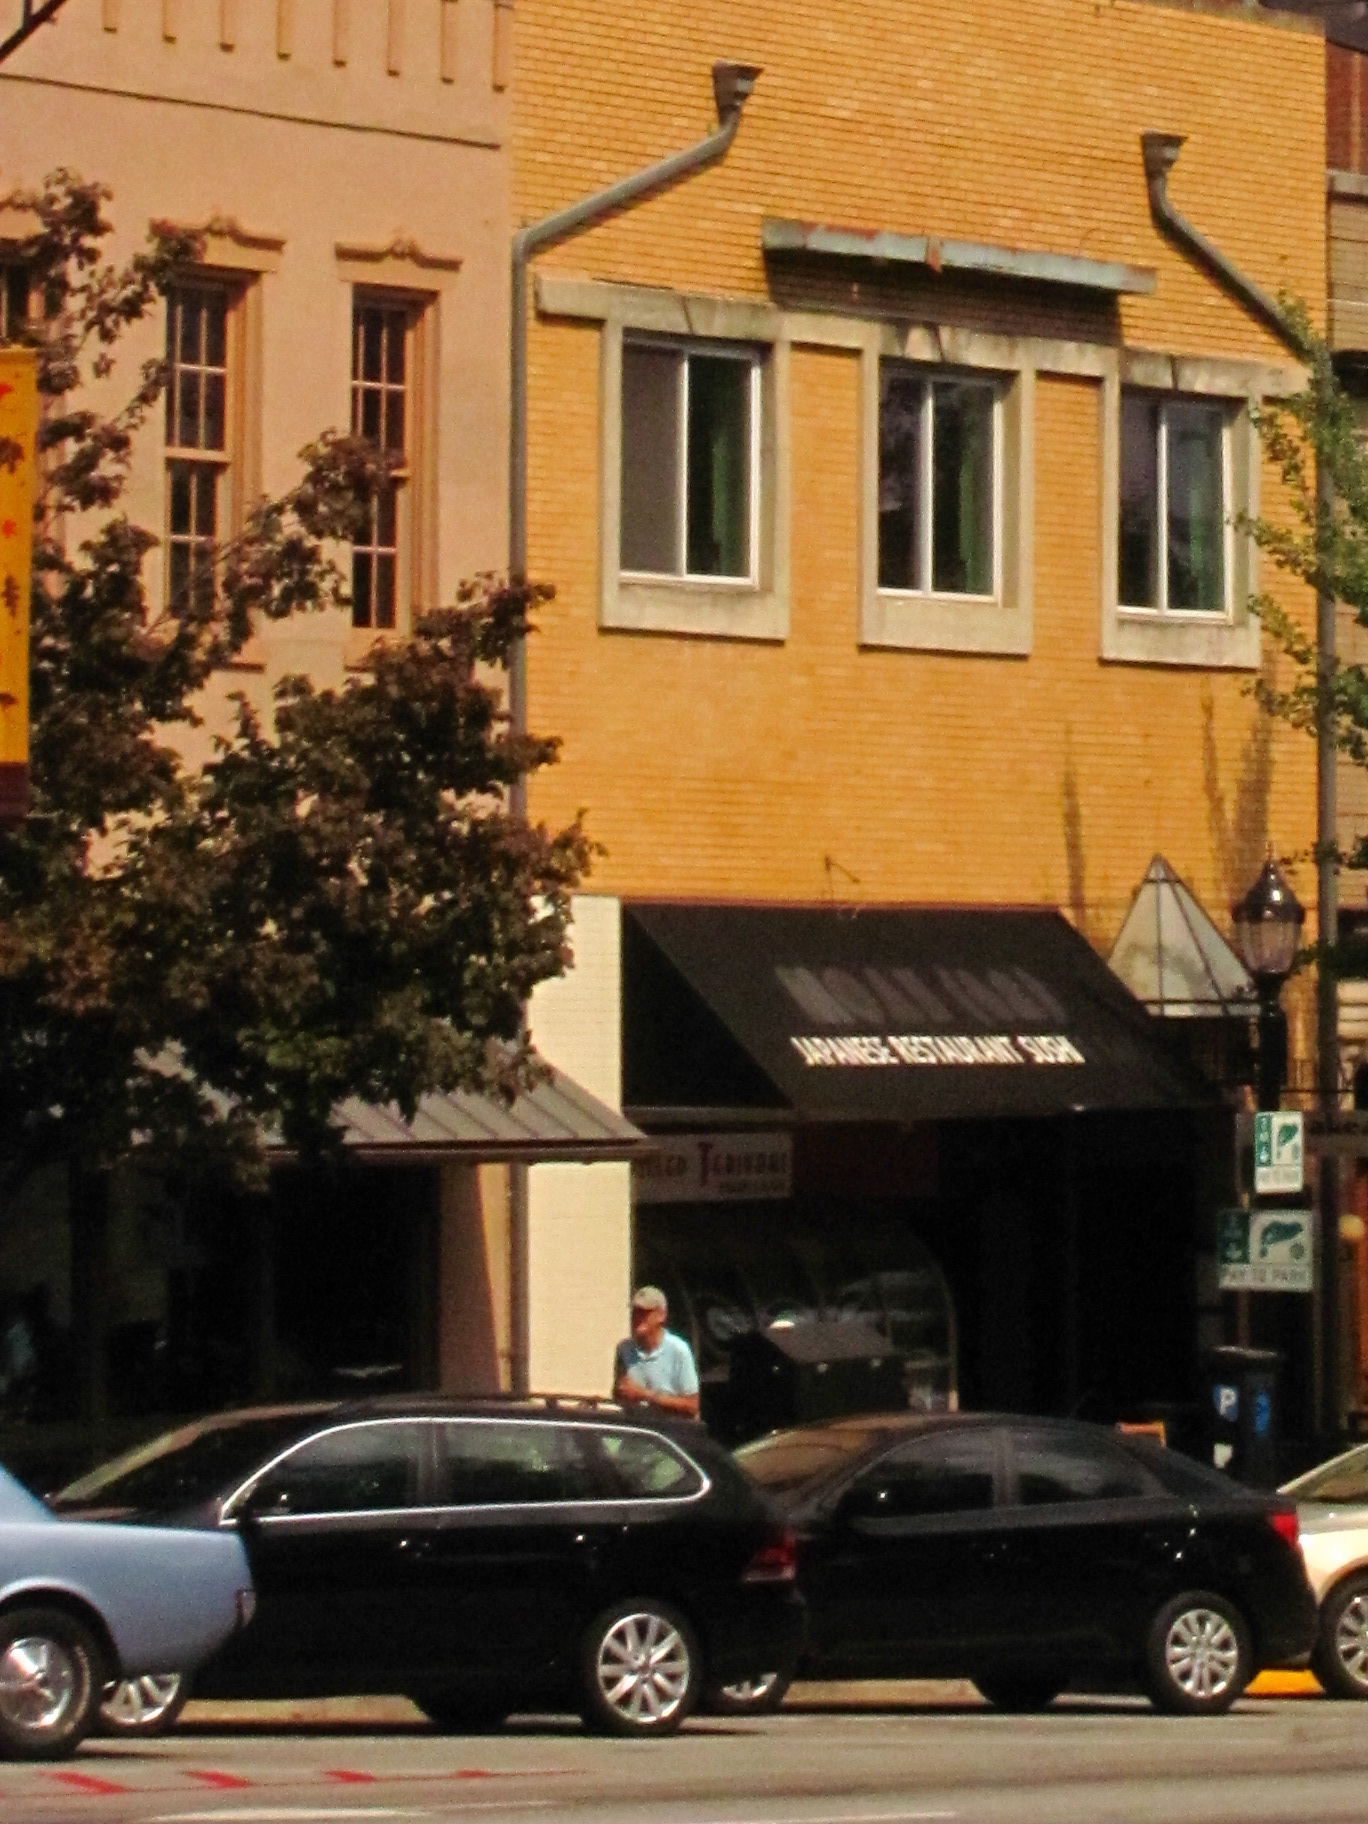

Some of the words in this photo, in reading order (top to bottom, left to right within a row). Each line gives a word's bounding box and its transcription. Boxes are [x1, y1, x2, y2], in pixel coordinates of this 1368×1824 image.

[789, 1035, 899, 1066] JAPANESE
[886, 1035, 1025, 1065] RESTAURANT
[1015, 1035, 1086, 1064] SUSHI
